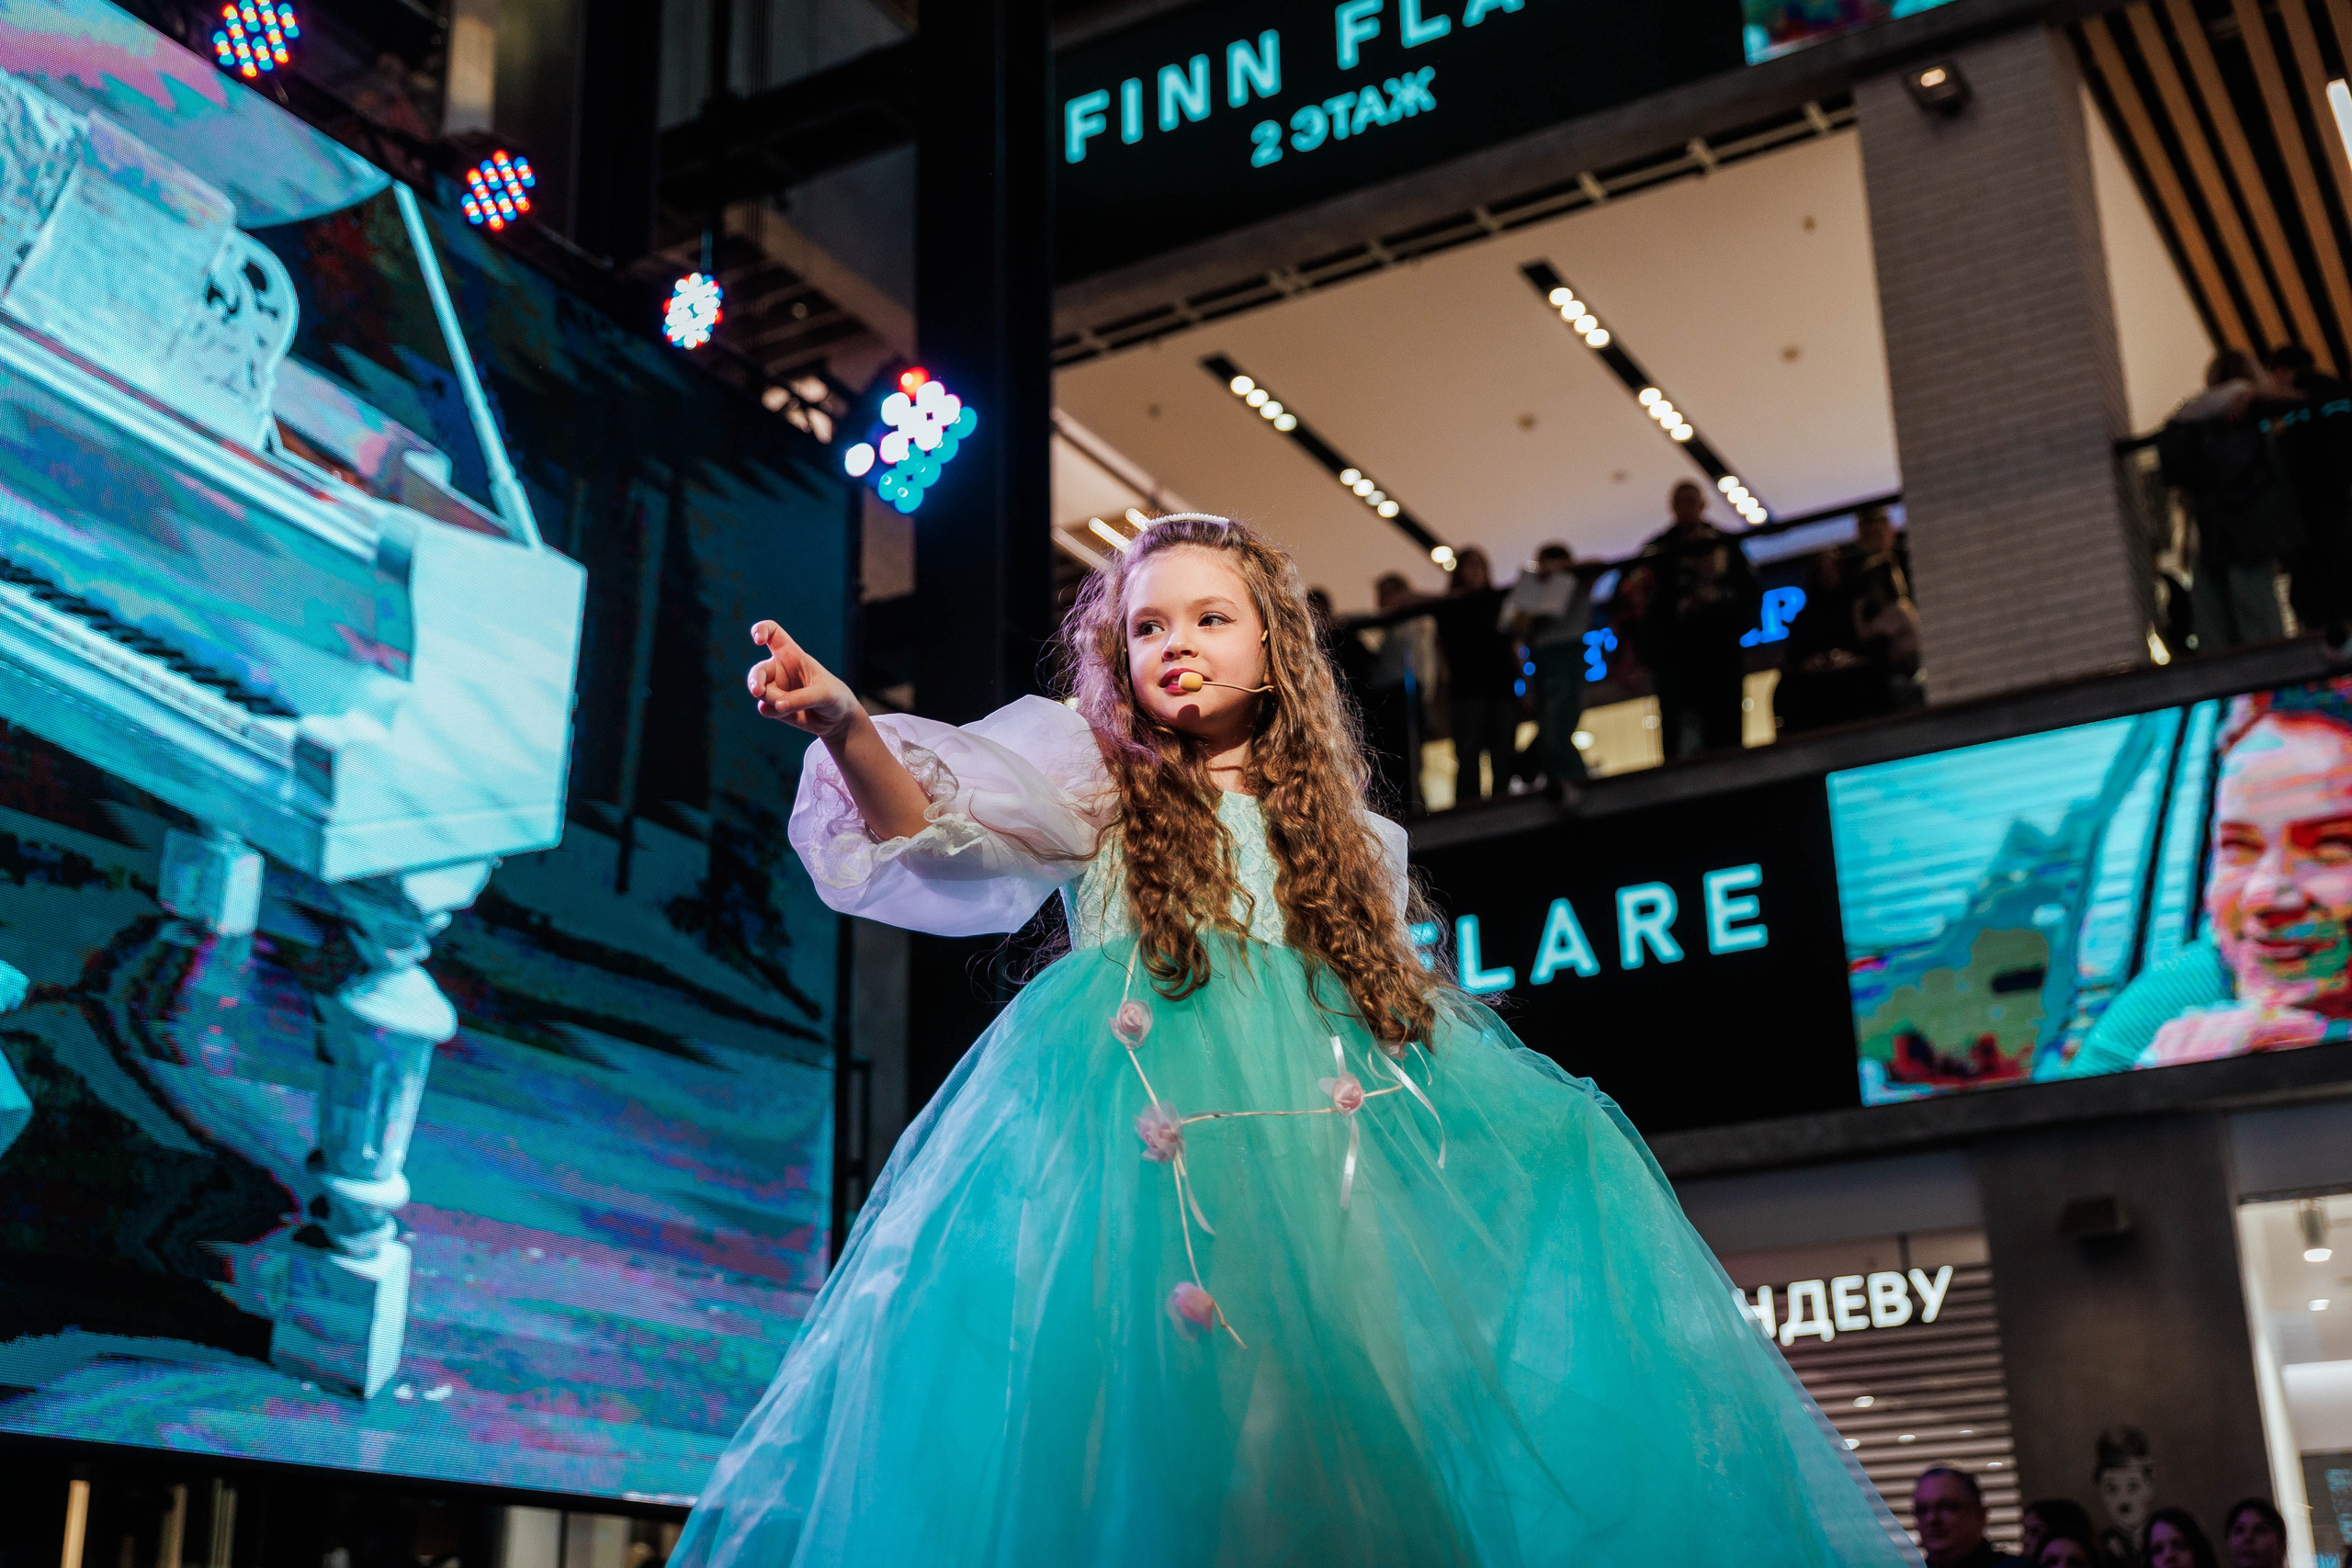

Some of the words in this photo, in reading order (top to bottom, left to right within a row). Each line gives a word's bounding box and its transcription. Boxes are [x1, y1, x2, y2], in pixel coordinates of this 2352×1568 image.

[1064, 28, 1282, 164] FINN
[1250, 119, 1283, 168] 2
[1290, 65, 1437, 152] ЭТАЖ
